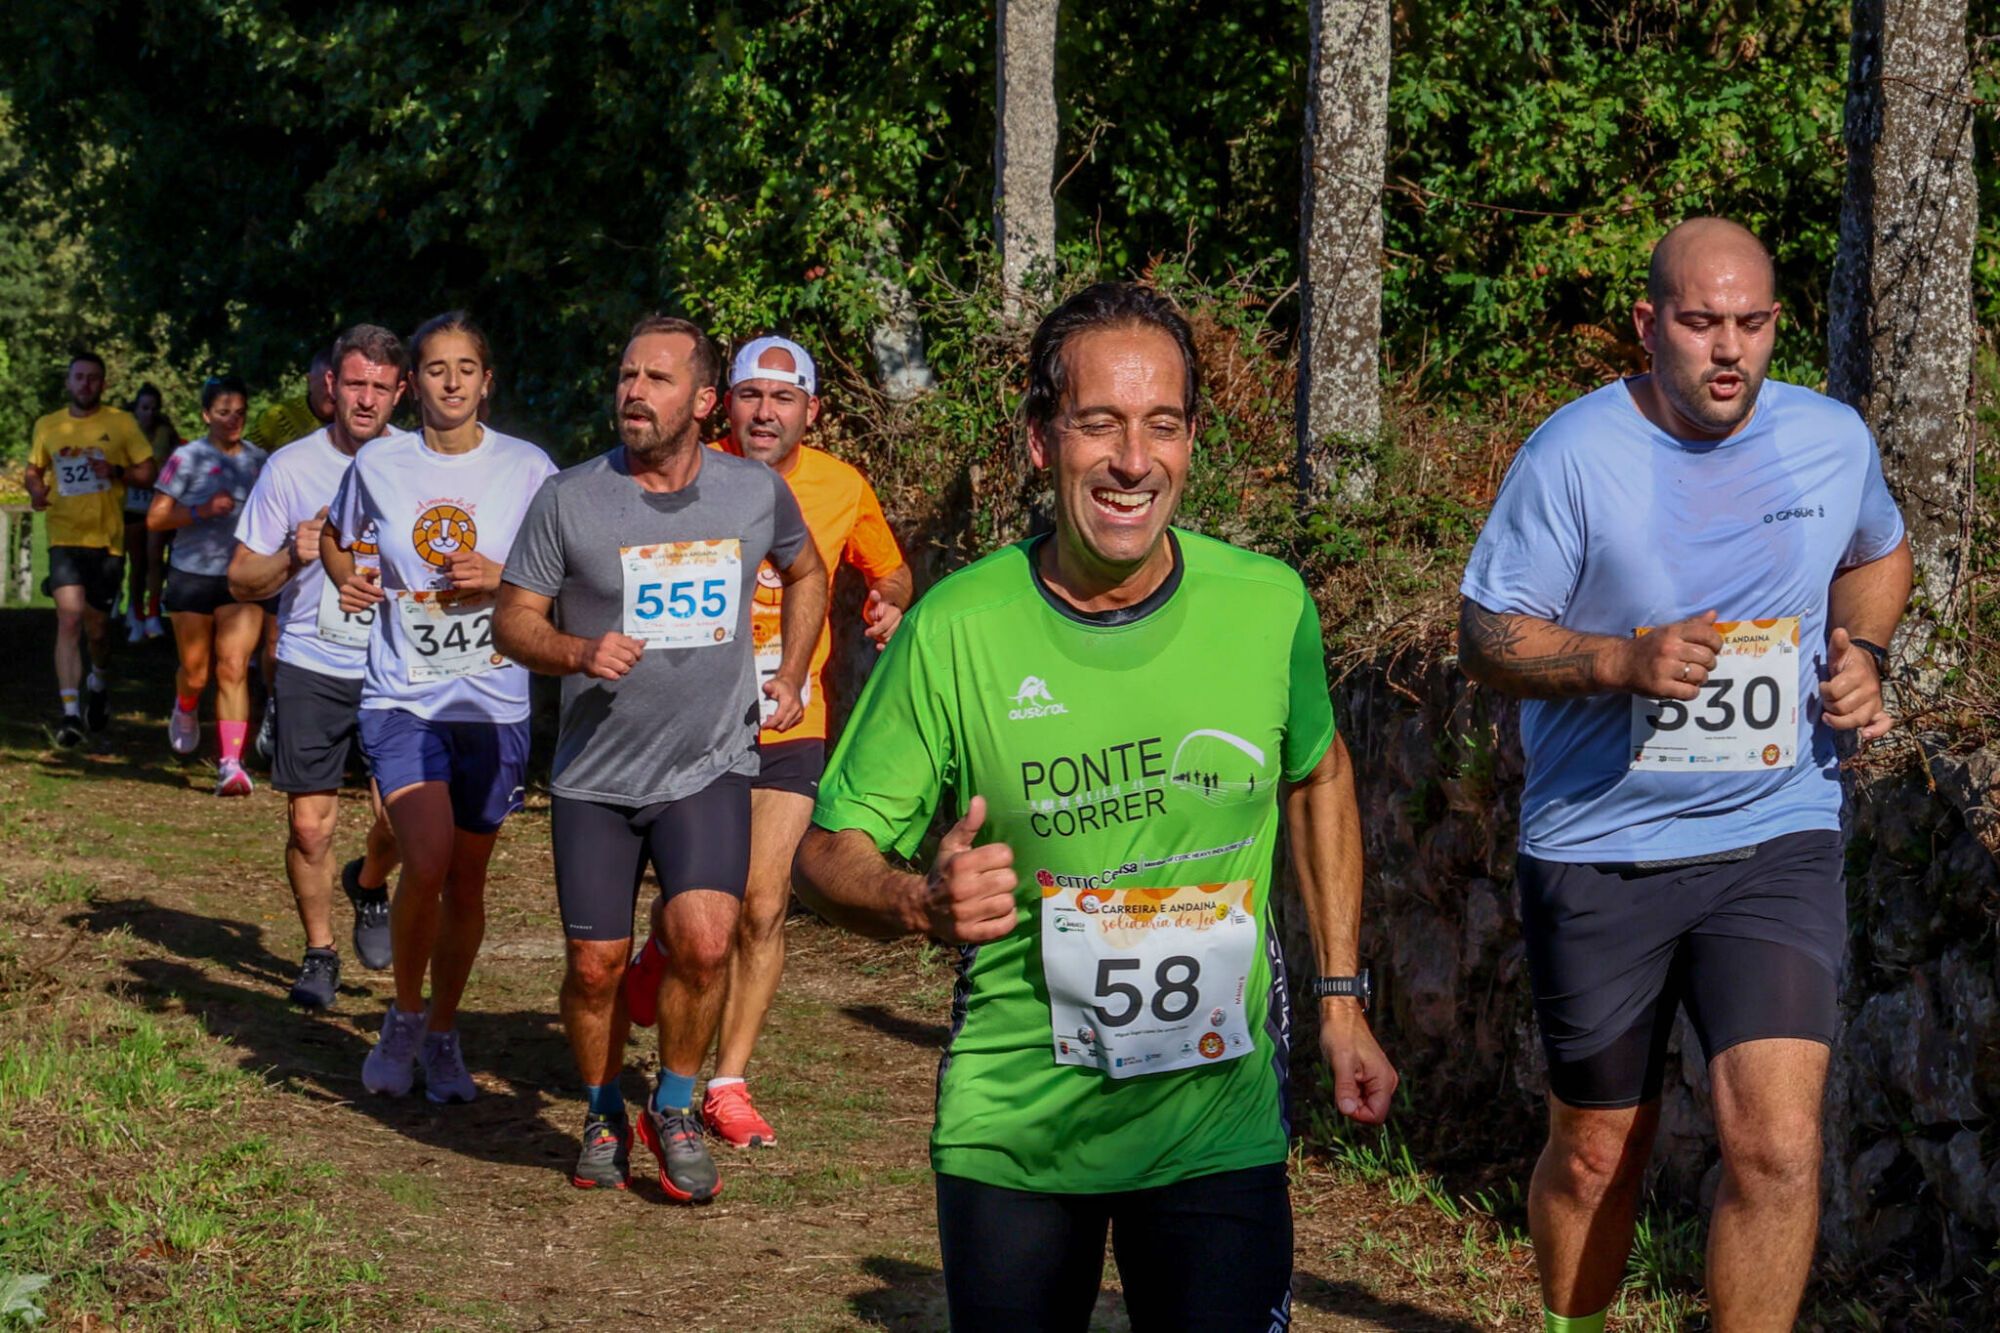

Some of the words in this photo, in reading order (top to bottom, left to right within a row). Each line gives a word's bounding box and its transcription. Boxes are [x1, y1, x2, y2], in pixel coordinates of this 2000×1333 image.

[635, 579, 727, 620] 555
[412, 614, 493, 657] 342
[1732, 635, 1770, 643] ANDAINA
[1021, 737, 1166, 801] PONTE
[1030, 788, 1167, 838] CORRER
[1056, 874, 1100, 890] CITIC
[1101, 903, 1157, 914] CARREIRA
[1160, 903, 1167, 912] E
[1168, 901, 1217, 912] ANDAINA
[1094, 955, 1201, 1028] 58
